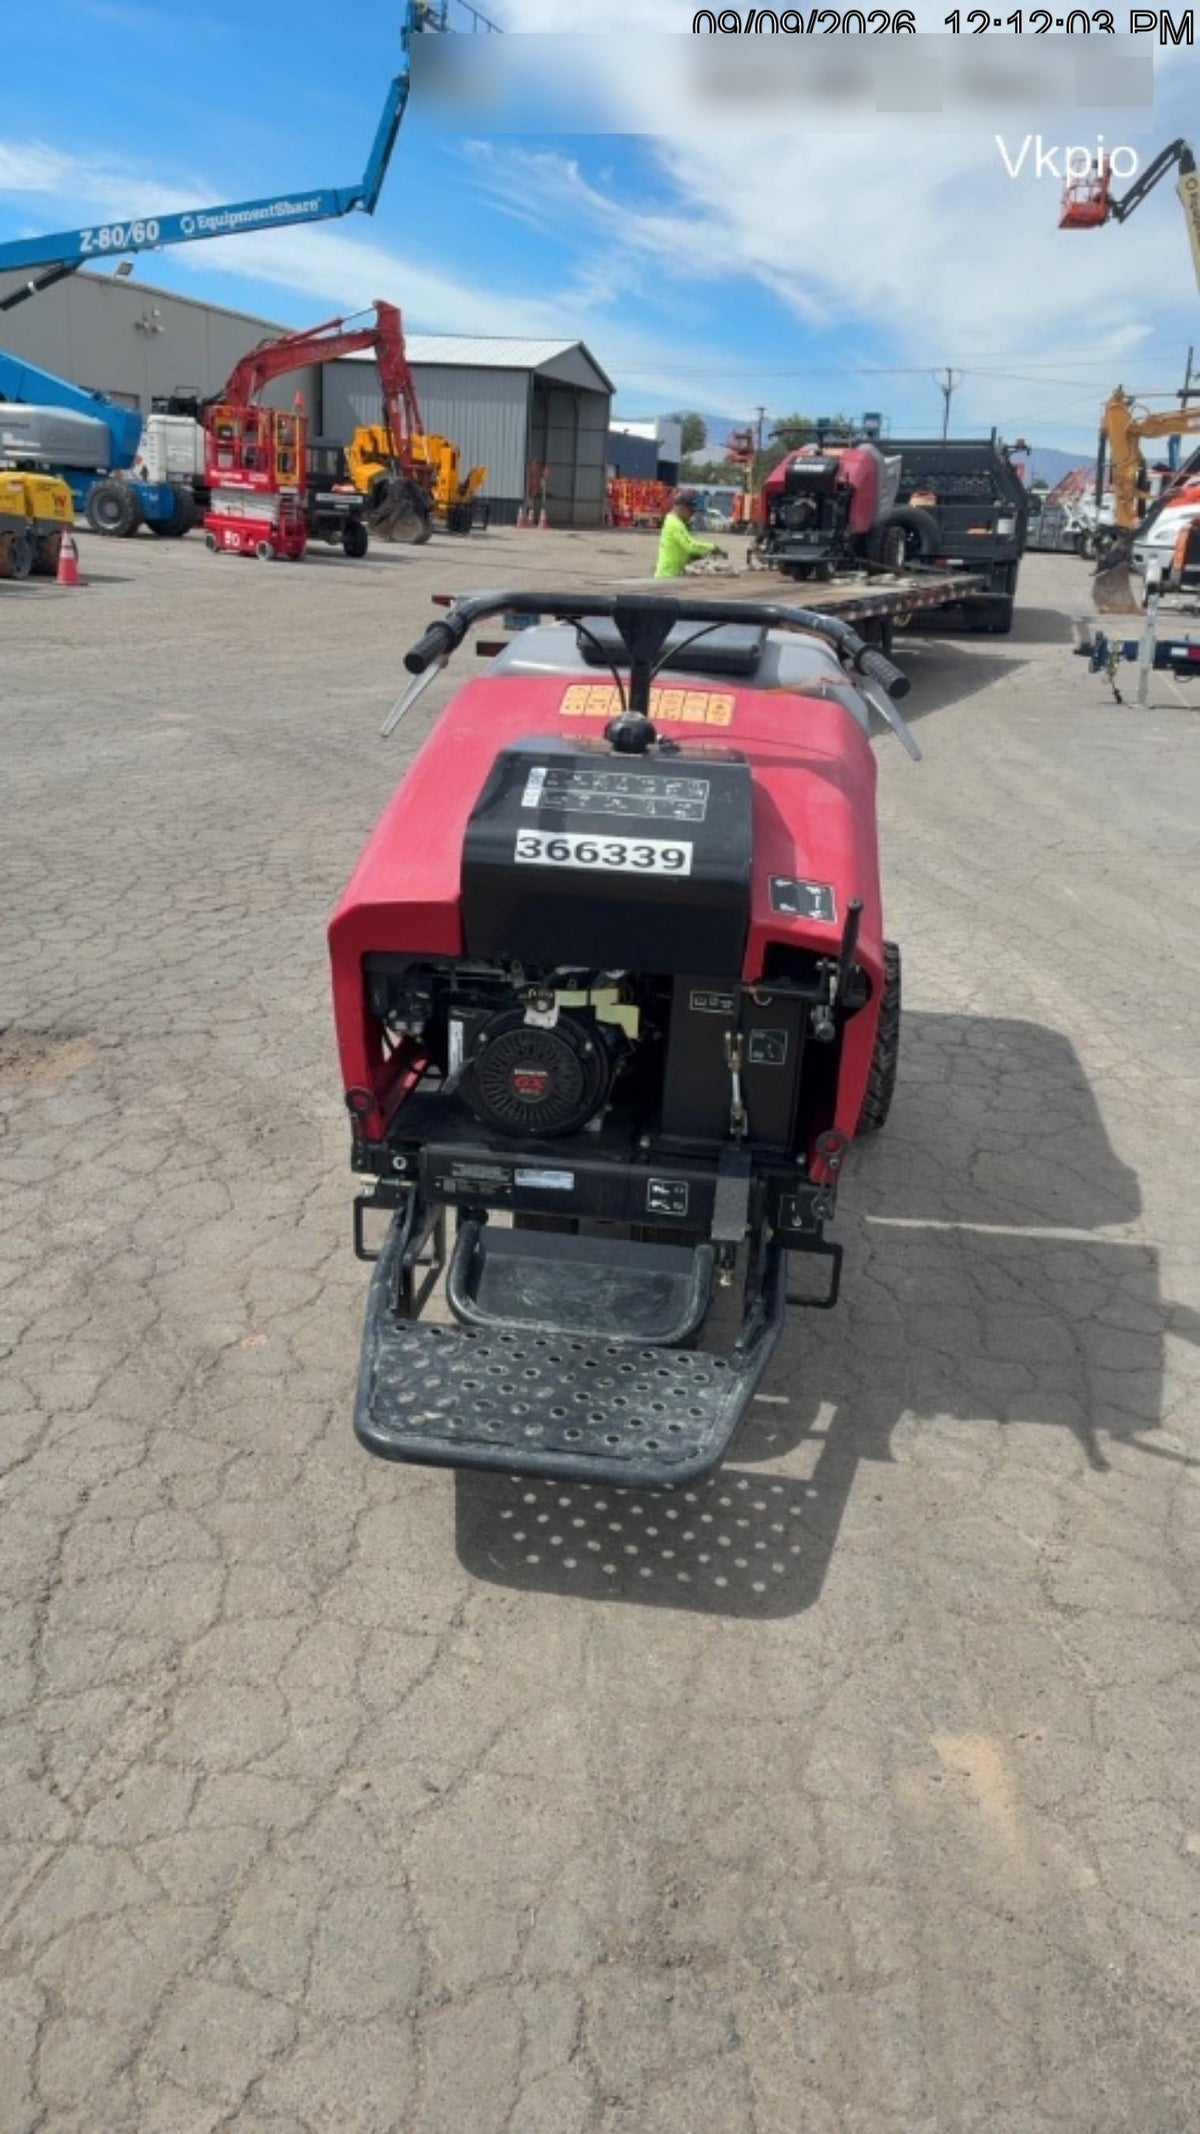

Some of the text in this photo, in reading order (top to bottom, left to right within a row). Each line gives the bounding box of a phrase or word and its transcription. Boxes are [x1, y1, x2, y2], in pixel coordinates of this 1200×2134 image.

[197, 200, 320, 230] EquipmentShare
[79, 220, 160, 253] Z-80/60
[516, 836, 686, 870] 366339
